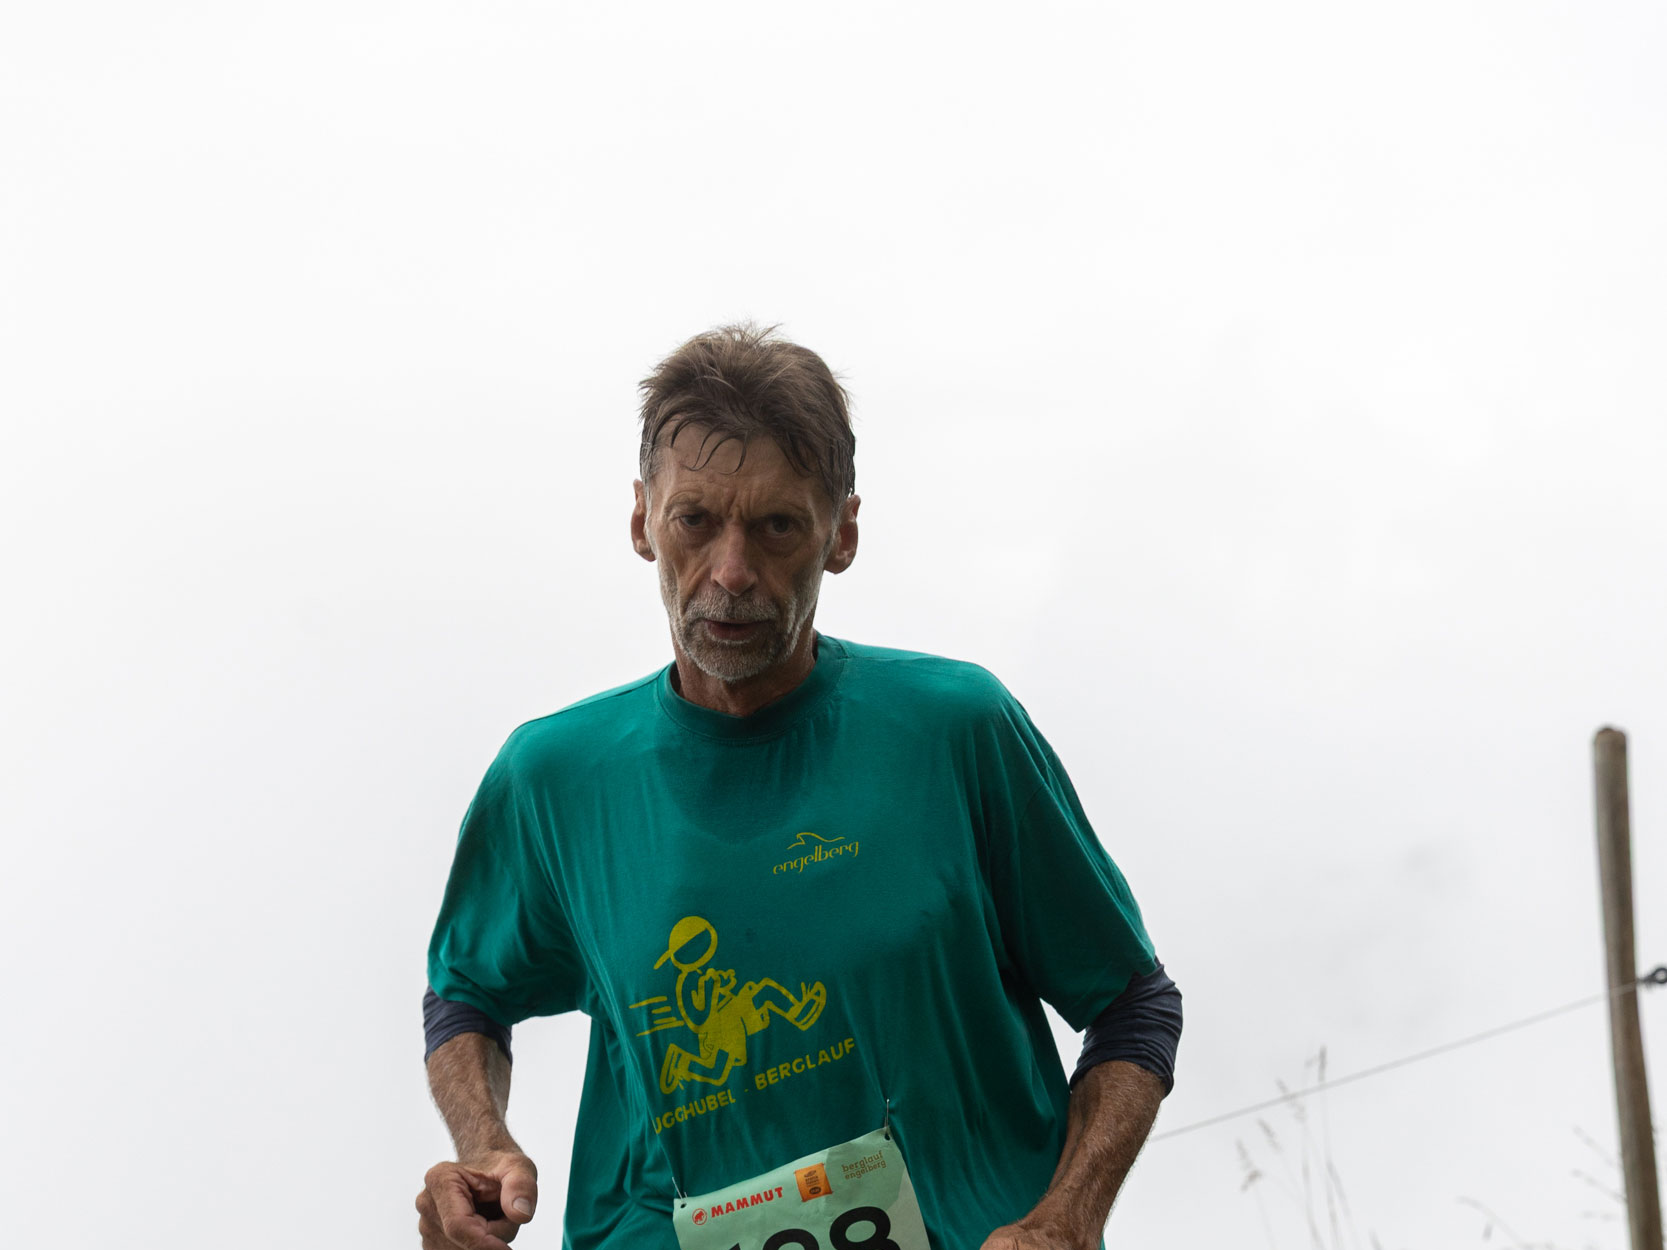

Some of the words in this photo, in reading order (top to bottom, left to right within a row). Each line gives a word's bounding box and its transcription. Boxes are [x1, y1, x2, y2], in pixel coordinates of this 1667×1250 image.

[772, 840, 859, 875] engelberg
[755, 1037, 857, 1091] BERGLAUF
[841, 1150, 884, 1173] berglauf
[844, 1159, 887, 1180] engelberg
[711, 1187, 784, 1218] MAMMUT
